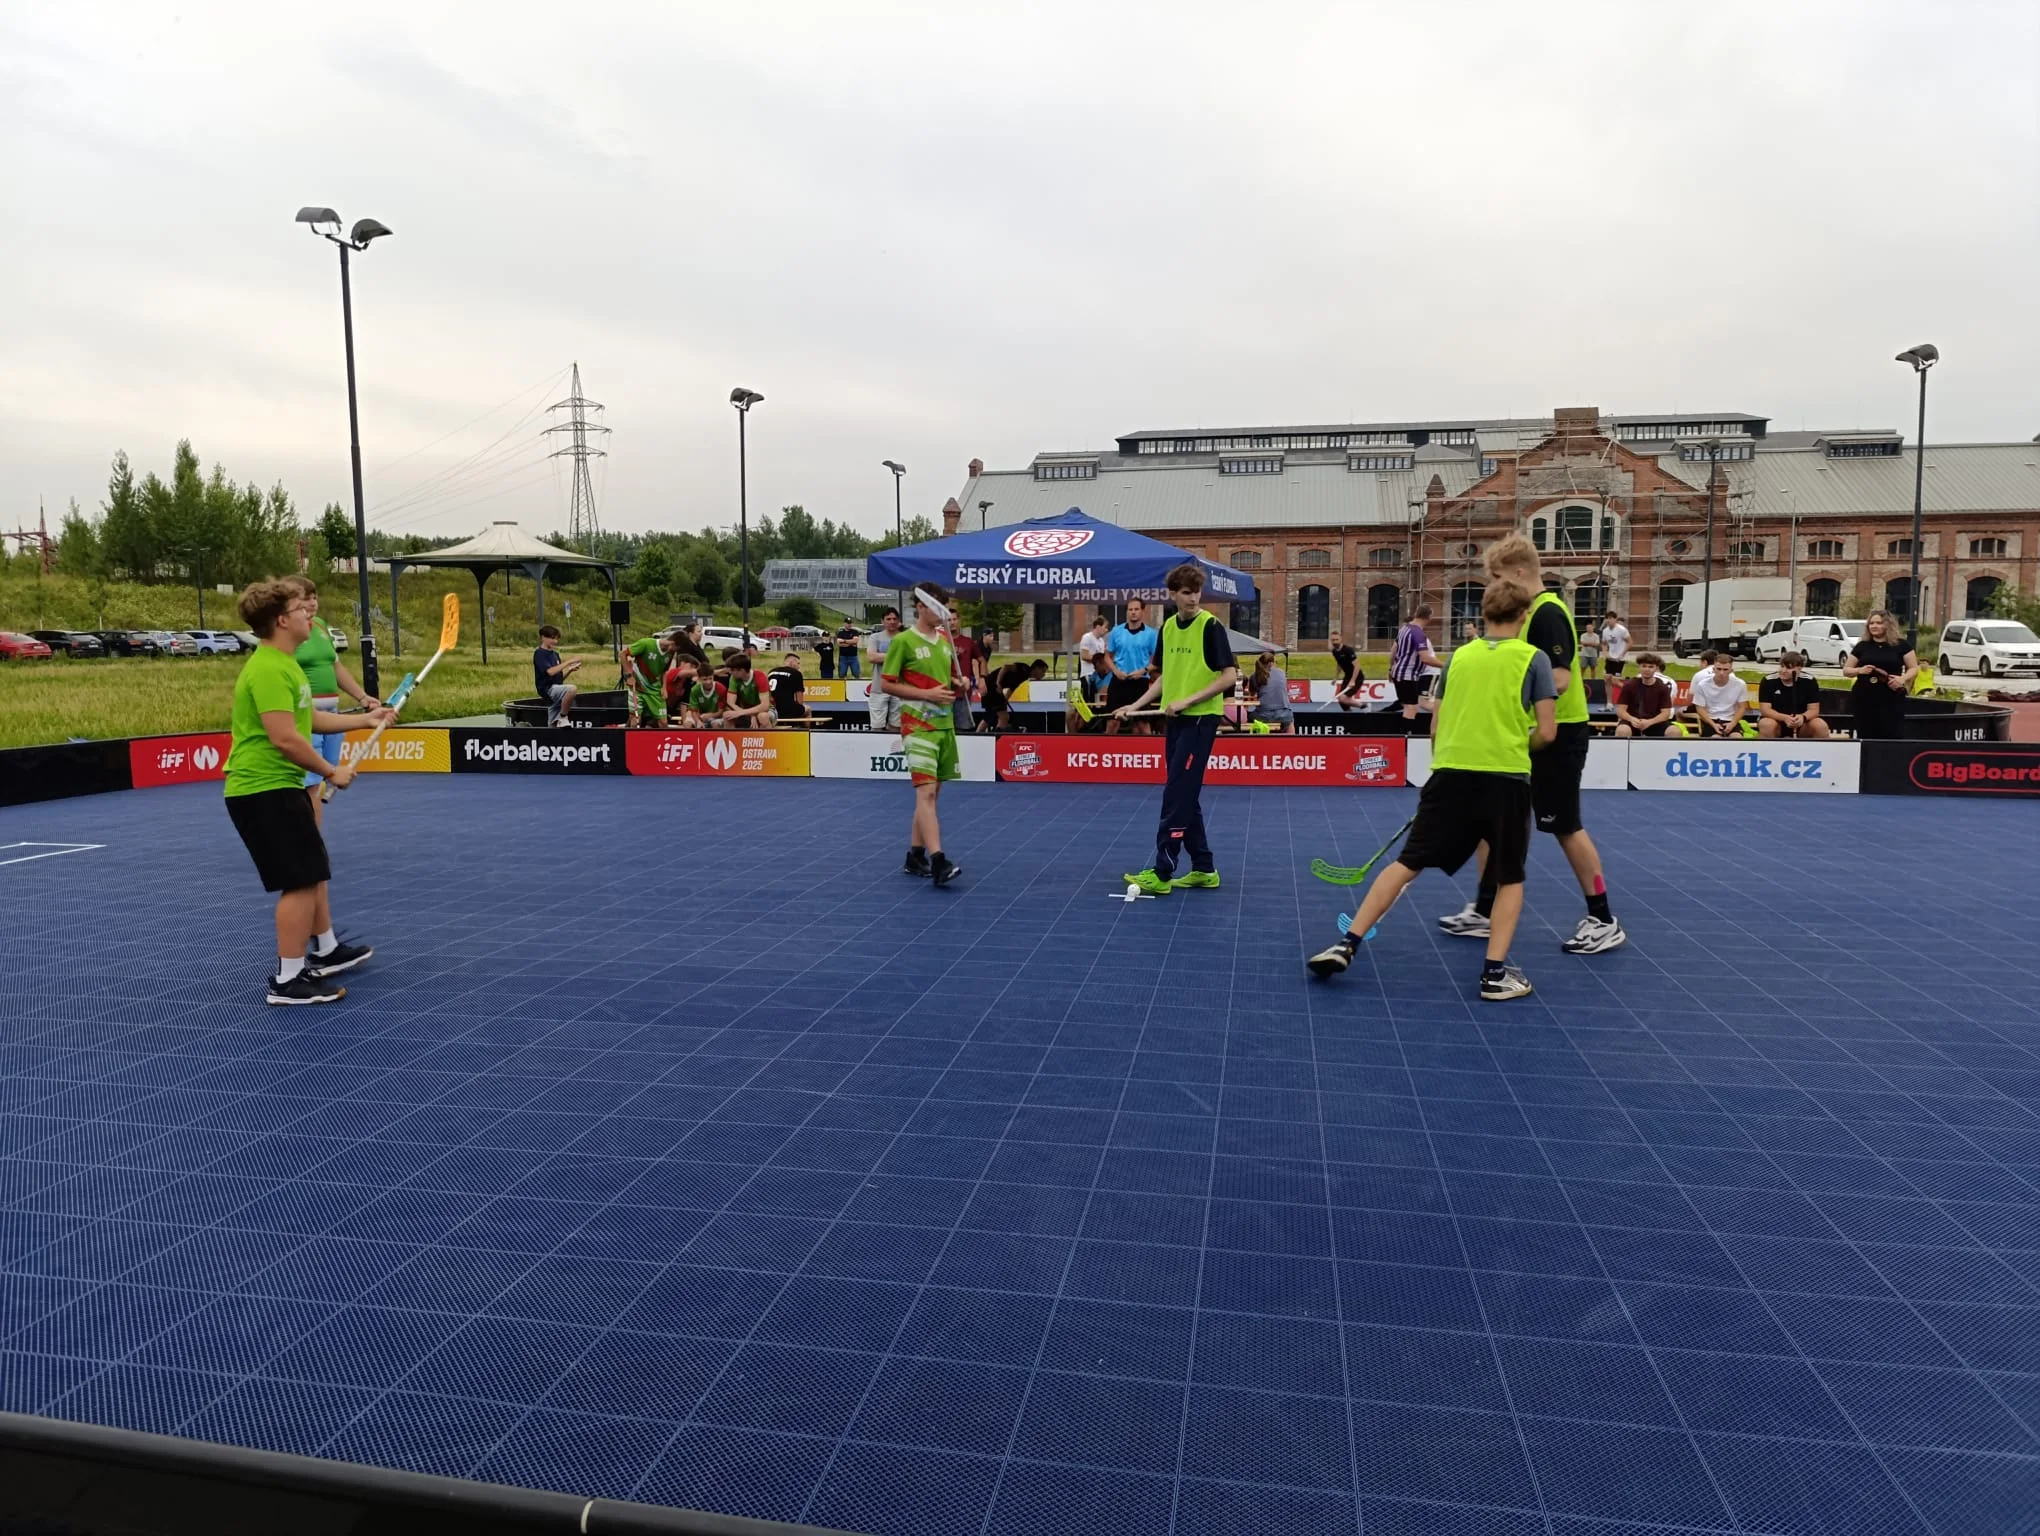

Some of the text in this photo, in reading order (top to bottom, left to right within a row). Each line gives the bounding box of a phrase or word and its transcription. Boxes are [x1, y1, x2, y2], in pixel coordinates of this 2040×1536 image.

[955, 562, 1095, 585] ČESKÝ FLORBAL
[384, 741, 425, 760] 2025
[742, 737, 765, 748] BRNO
[464, 739, 610, 766] florbalexpert
[742, 748, 777, 759] OSTRAVA
[1067, 753, 1098, 767] KFC
[1102, 753, 1162, 768] STREET
[1263, 756, 1326, 769] LEAGUE
[742, 760, 763, 770] 2025
[1666, 752, 1822, 779] deník.cz
